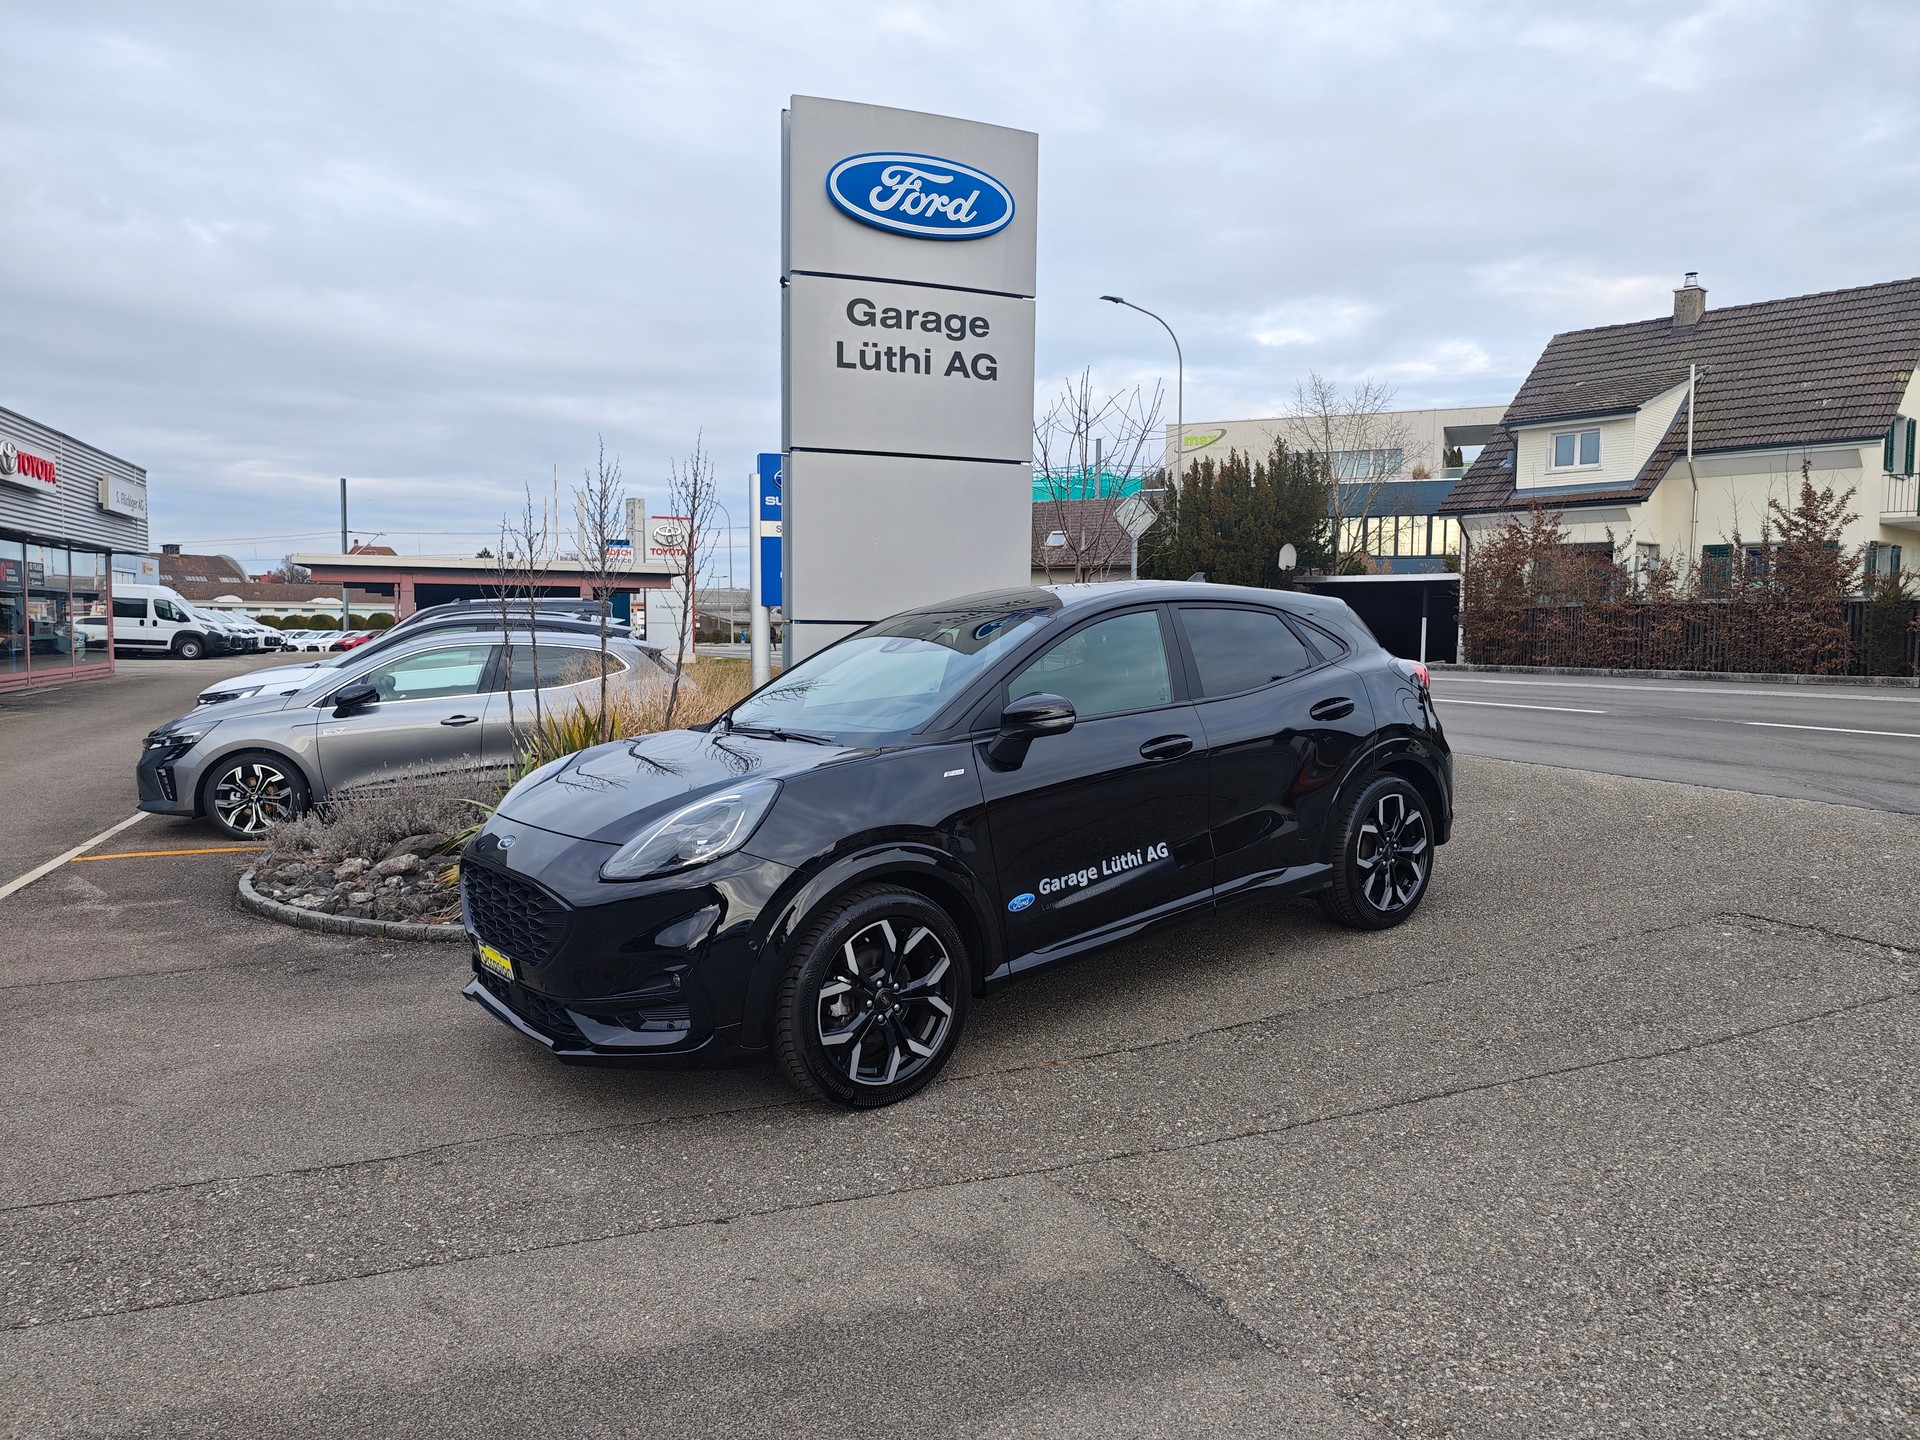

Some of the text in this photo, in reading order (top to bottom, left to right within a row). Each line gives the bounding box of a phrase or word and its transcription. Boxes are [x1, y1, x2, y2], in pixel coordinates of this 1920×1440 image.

[869, 165, 980, 223] Ford
[846, 297, 990, 341] Garage
[836, 341, 998, 381] Lüthi AG
[1183, 435, 1217, 446] max
[17, 451, 56, 484] TOYOTA
[650, 548, 687, 556] TOYOTA
[1038, 842, 1169, 895] Garage Lüthi AG
